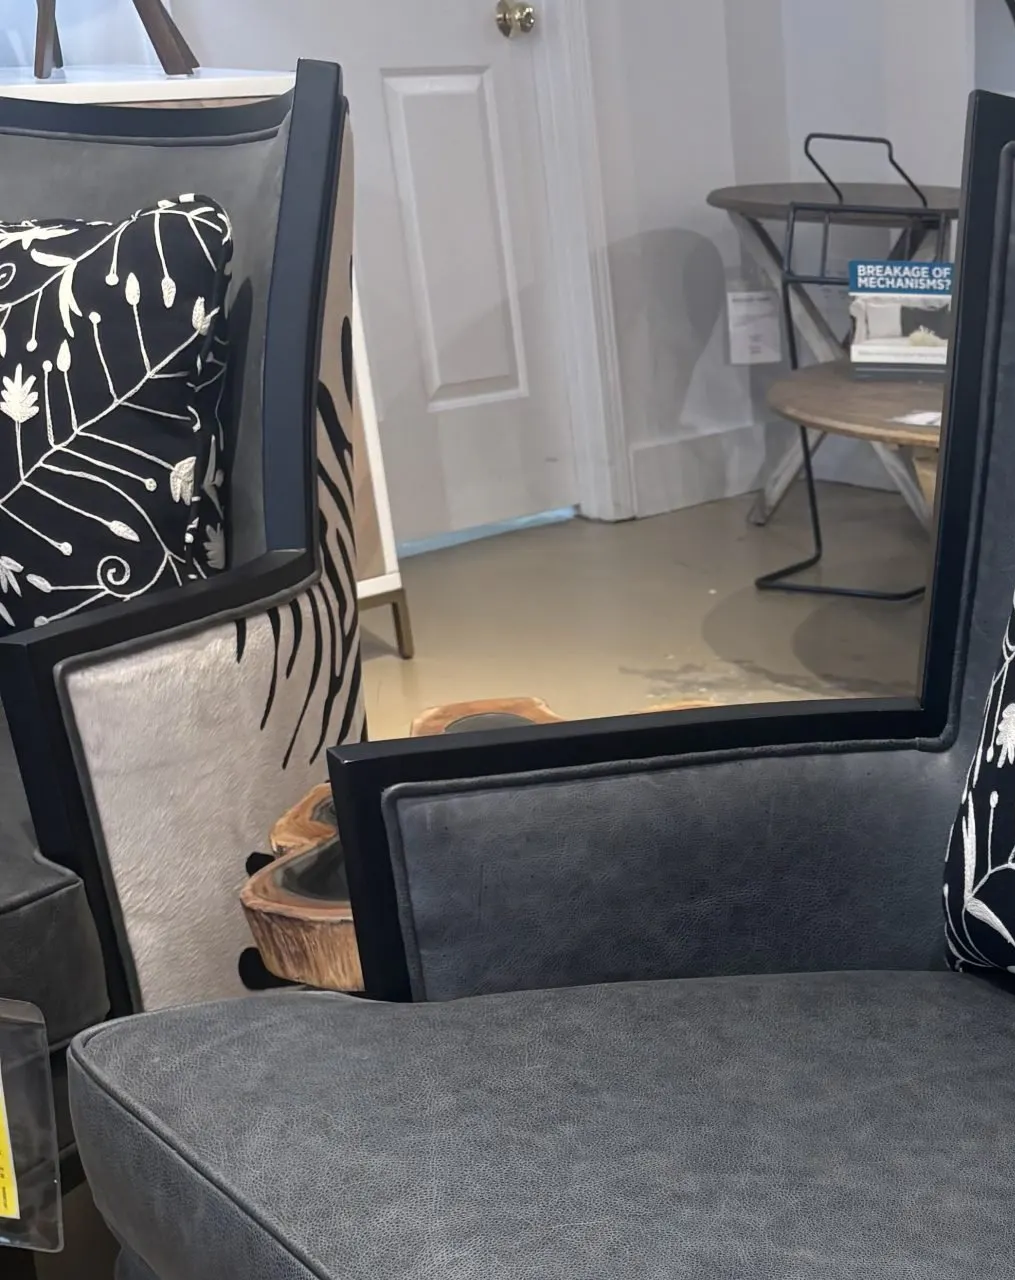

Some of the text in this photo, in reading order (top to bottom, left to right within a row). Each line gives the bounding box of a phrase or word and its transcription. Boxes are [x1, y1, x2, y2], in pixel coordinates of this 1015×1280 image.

[857, 264, 951, 278] BREAKAGE OF
[857, 276, 952, 290] MECHANISMS?
